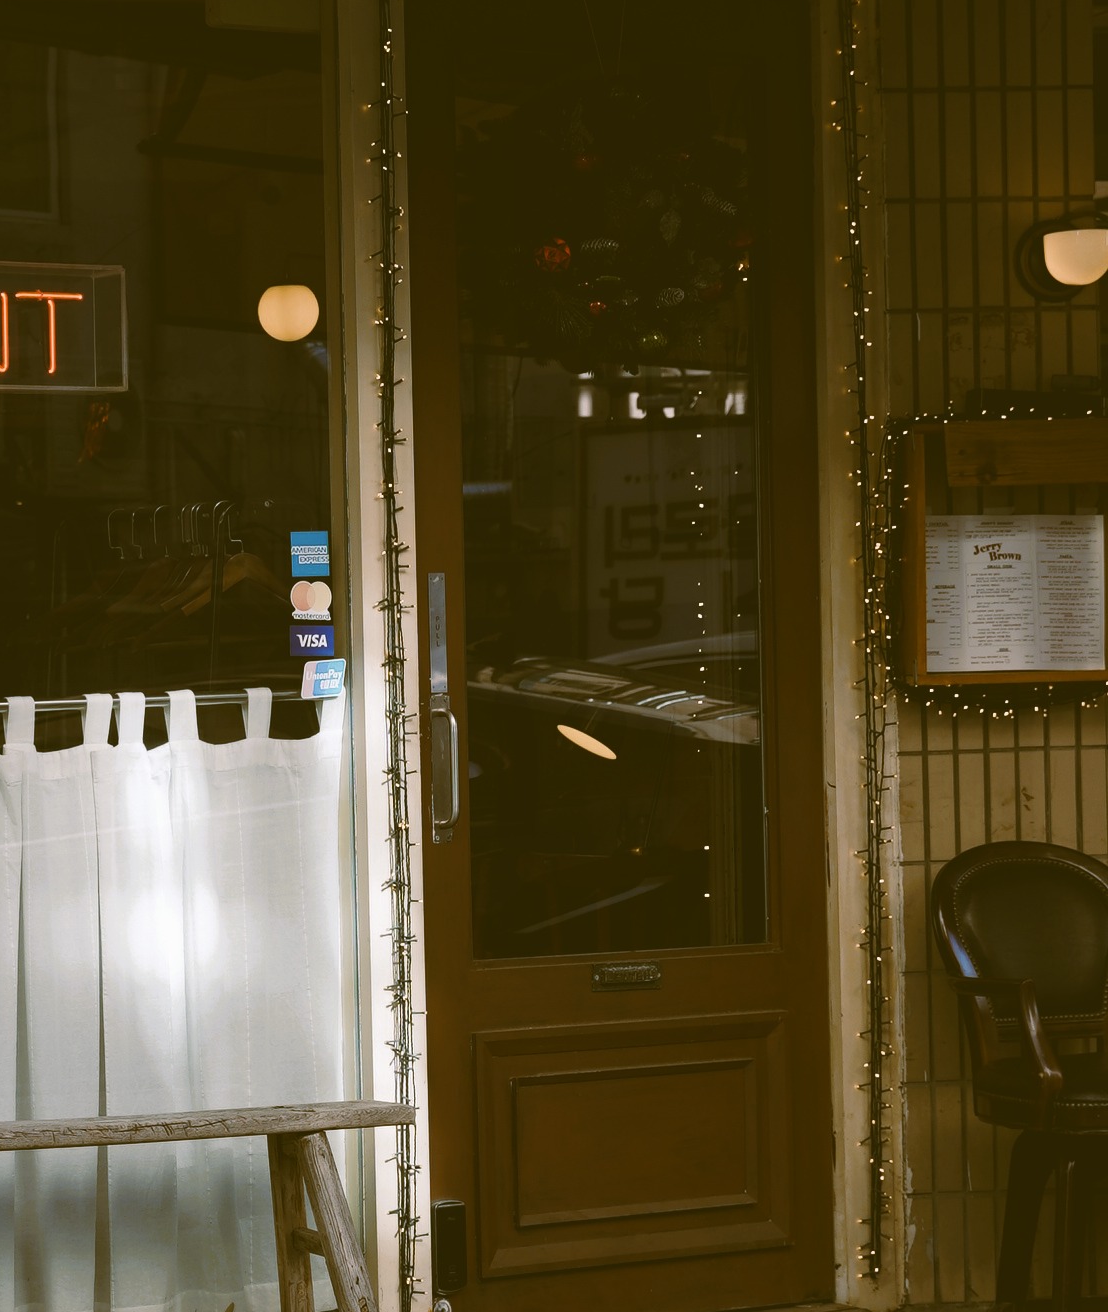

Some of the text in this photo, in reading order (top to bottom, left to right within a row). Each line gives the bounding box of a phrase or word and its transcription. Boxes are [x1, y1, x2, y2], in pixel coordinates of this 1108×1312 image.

[292, 546, 327, 554] AMERICAN
[973, 543, 1003, 556] Jerry
[988, 551, 1022, 561] Brown
[293, 612, 330, 620] mastercard
[296, 634, 328, 648] VISA
[305, 669, 343, 680] UnionPay
